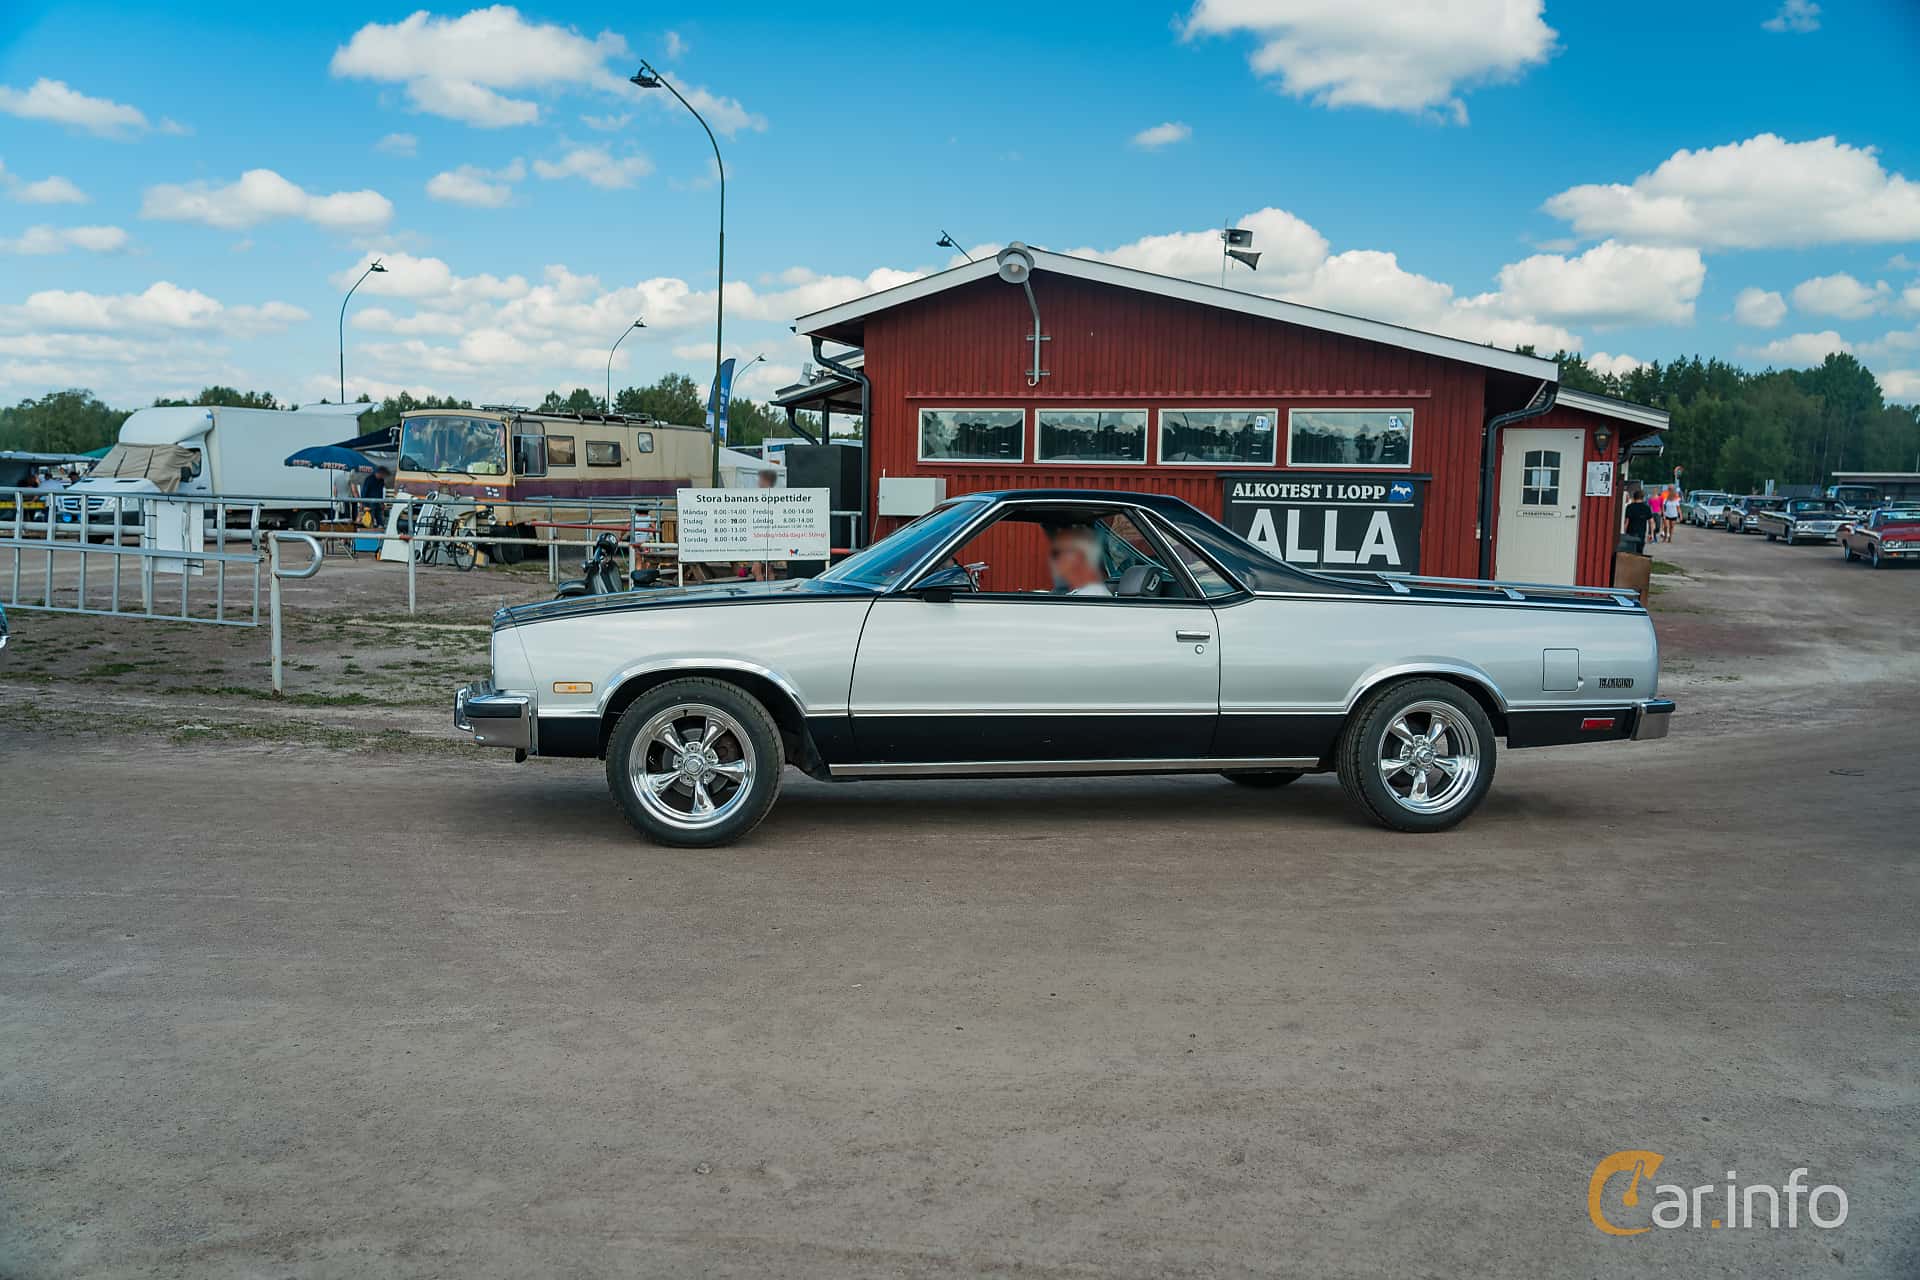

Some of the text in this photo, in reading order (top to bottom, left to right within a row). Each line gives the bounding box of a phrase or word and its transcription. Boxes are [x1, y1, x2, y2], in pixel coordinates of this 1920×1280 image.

[696, 493, 812, 504] Stora banans öppettider
[1232, 482, 1386, 500] ALKOTEST I LOPP
[1247, 508, 1401, 565] ALLA
